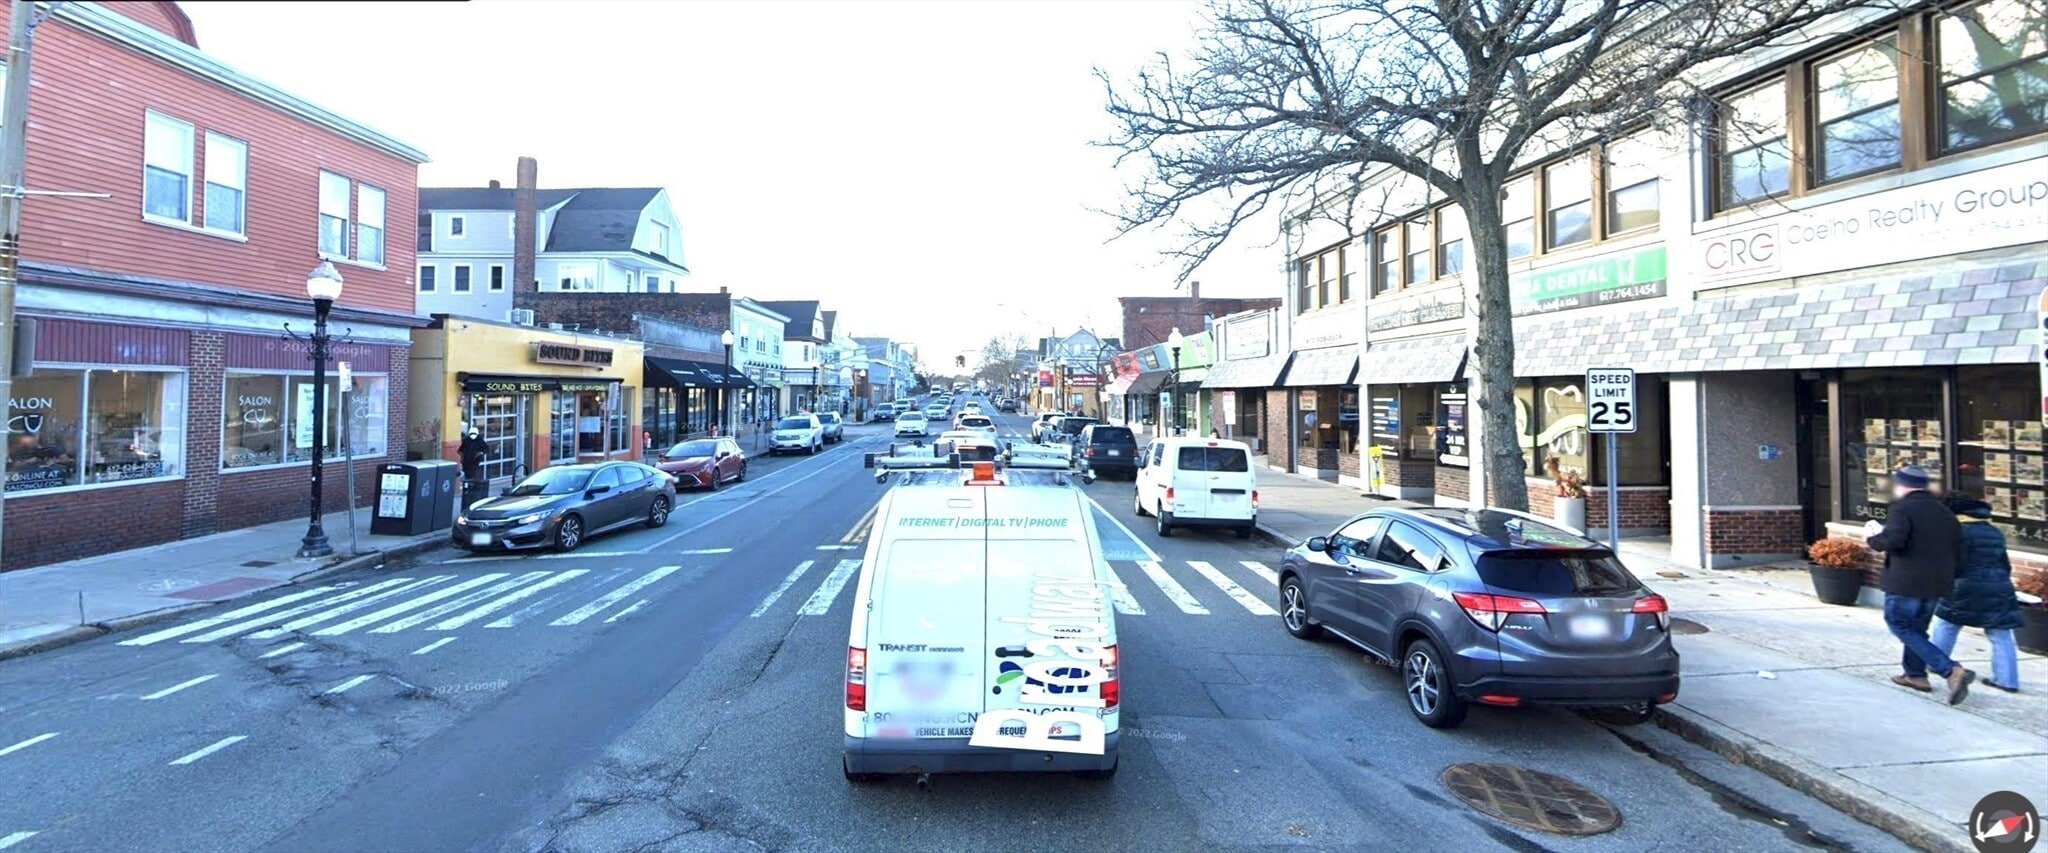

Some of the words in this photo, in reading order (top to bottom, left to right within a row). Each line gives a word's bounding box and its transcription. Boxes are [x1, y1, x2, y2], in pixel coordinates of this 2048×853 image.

[1869, 199, 1944, 230] Realty
[1954, 179, 2048, 215] Group
[1704, 232, 1774, 270] CRG
[1546, 265, 1609, 289] DENTAL
[540, 344, 581, 361] SOUND
[1591, 374, 1630, 384] SPEED
[486, 382, 516, 392] SOUND
[521, 383, 542, 392] BITES
[1595, 388, 1627, 397] LIMIT
[7, 397, 53, 410] ALON
[239, 395, 272, 406] SALON
[1591, 401, 1632, 425] 25
[1855, 504, 1888, 519] SALES
[960, 517, 1006, 529] DIGITAL
[1009, 518, 1023, 528] TV
[1029, 517, 1069, 529] PHONE
[878, 643, 928, 652] TRANSIT
[916, 726, 946, 737] VEHICLE
[948, 726, 974, 737] MAKES
